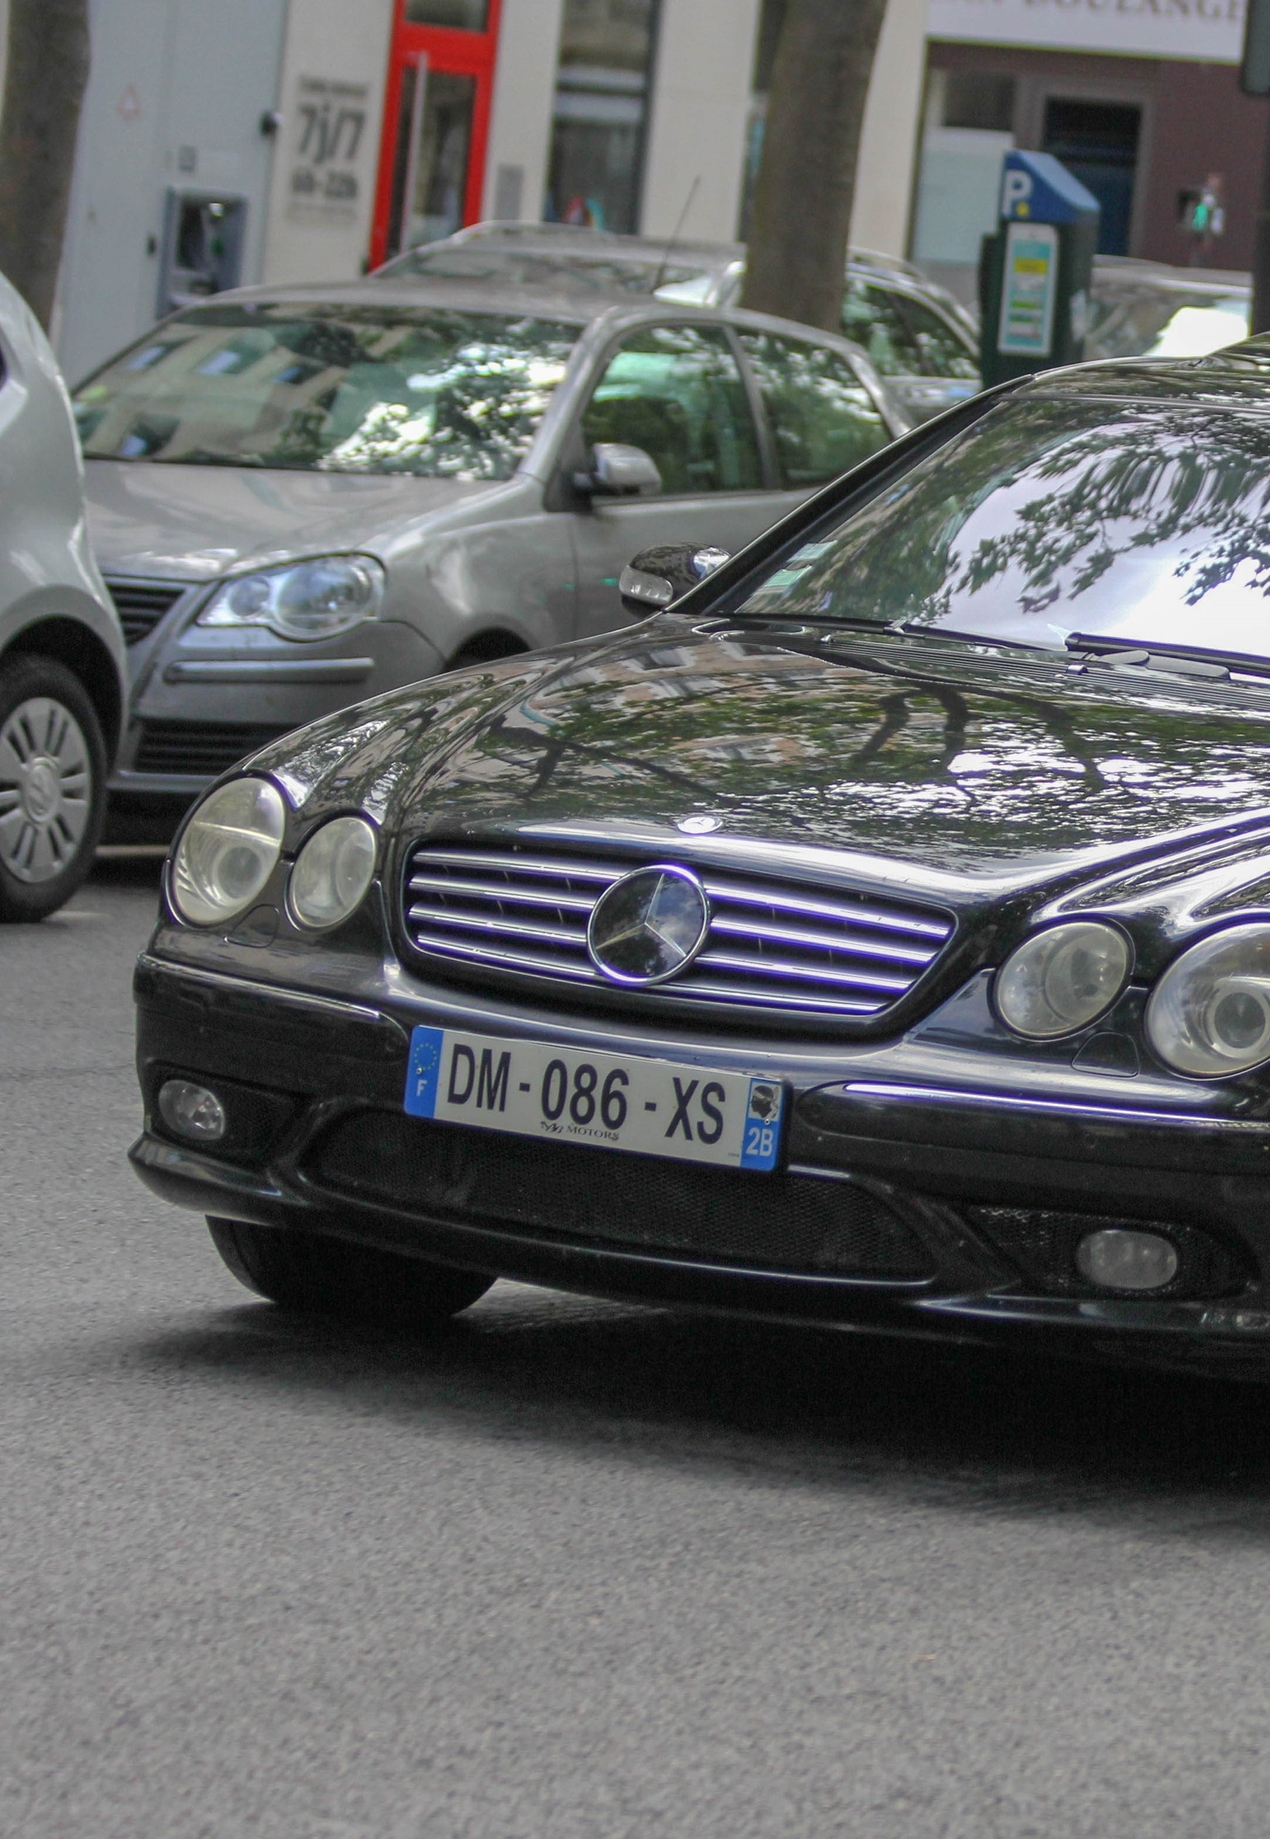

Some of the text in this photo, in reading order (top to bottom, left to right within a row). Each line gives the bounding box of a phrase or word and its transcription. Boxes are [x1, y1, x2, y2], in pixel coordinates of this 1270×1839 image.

[299, 103, 366, 165] 7j/7
[1003, 169, 1033, 216] P
[416, 1079, 428, 1097] F
[566, 1124, 620, 1142] MOTORS
[745, 1127, 774, 1157] 2B
